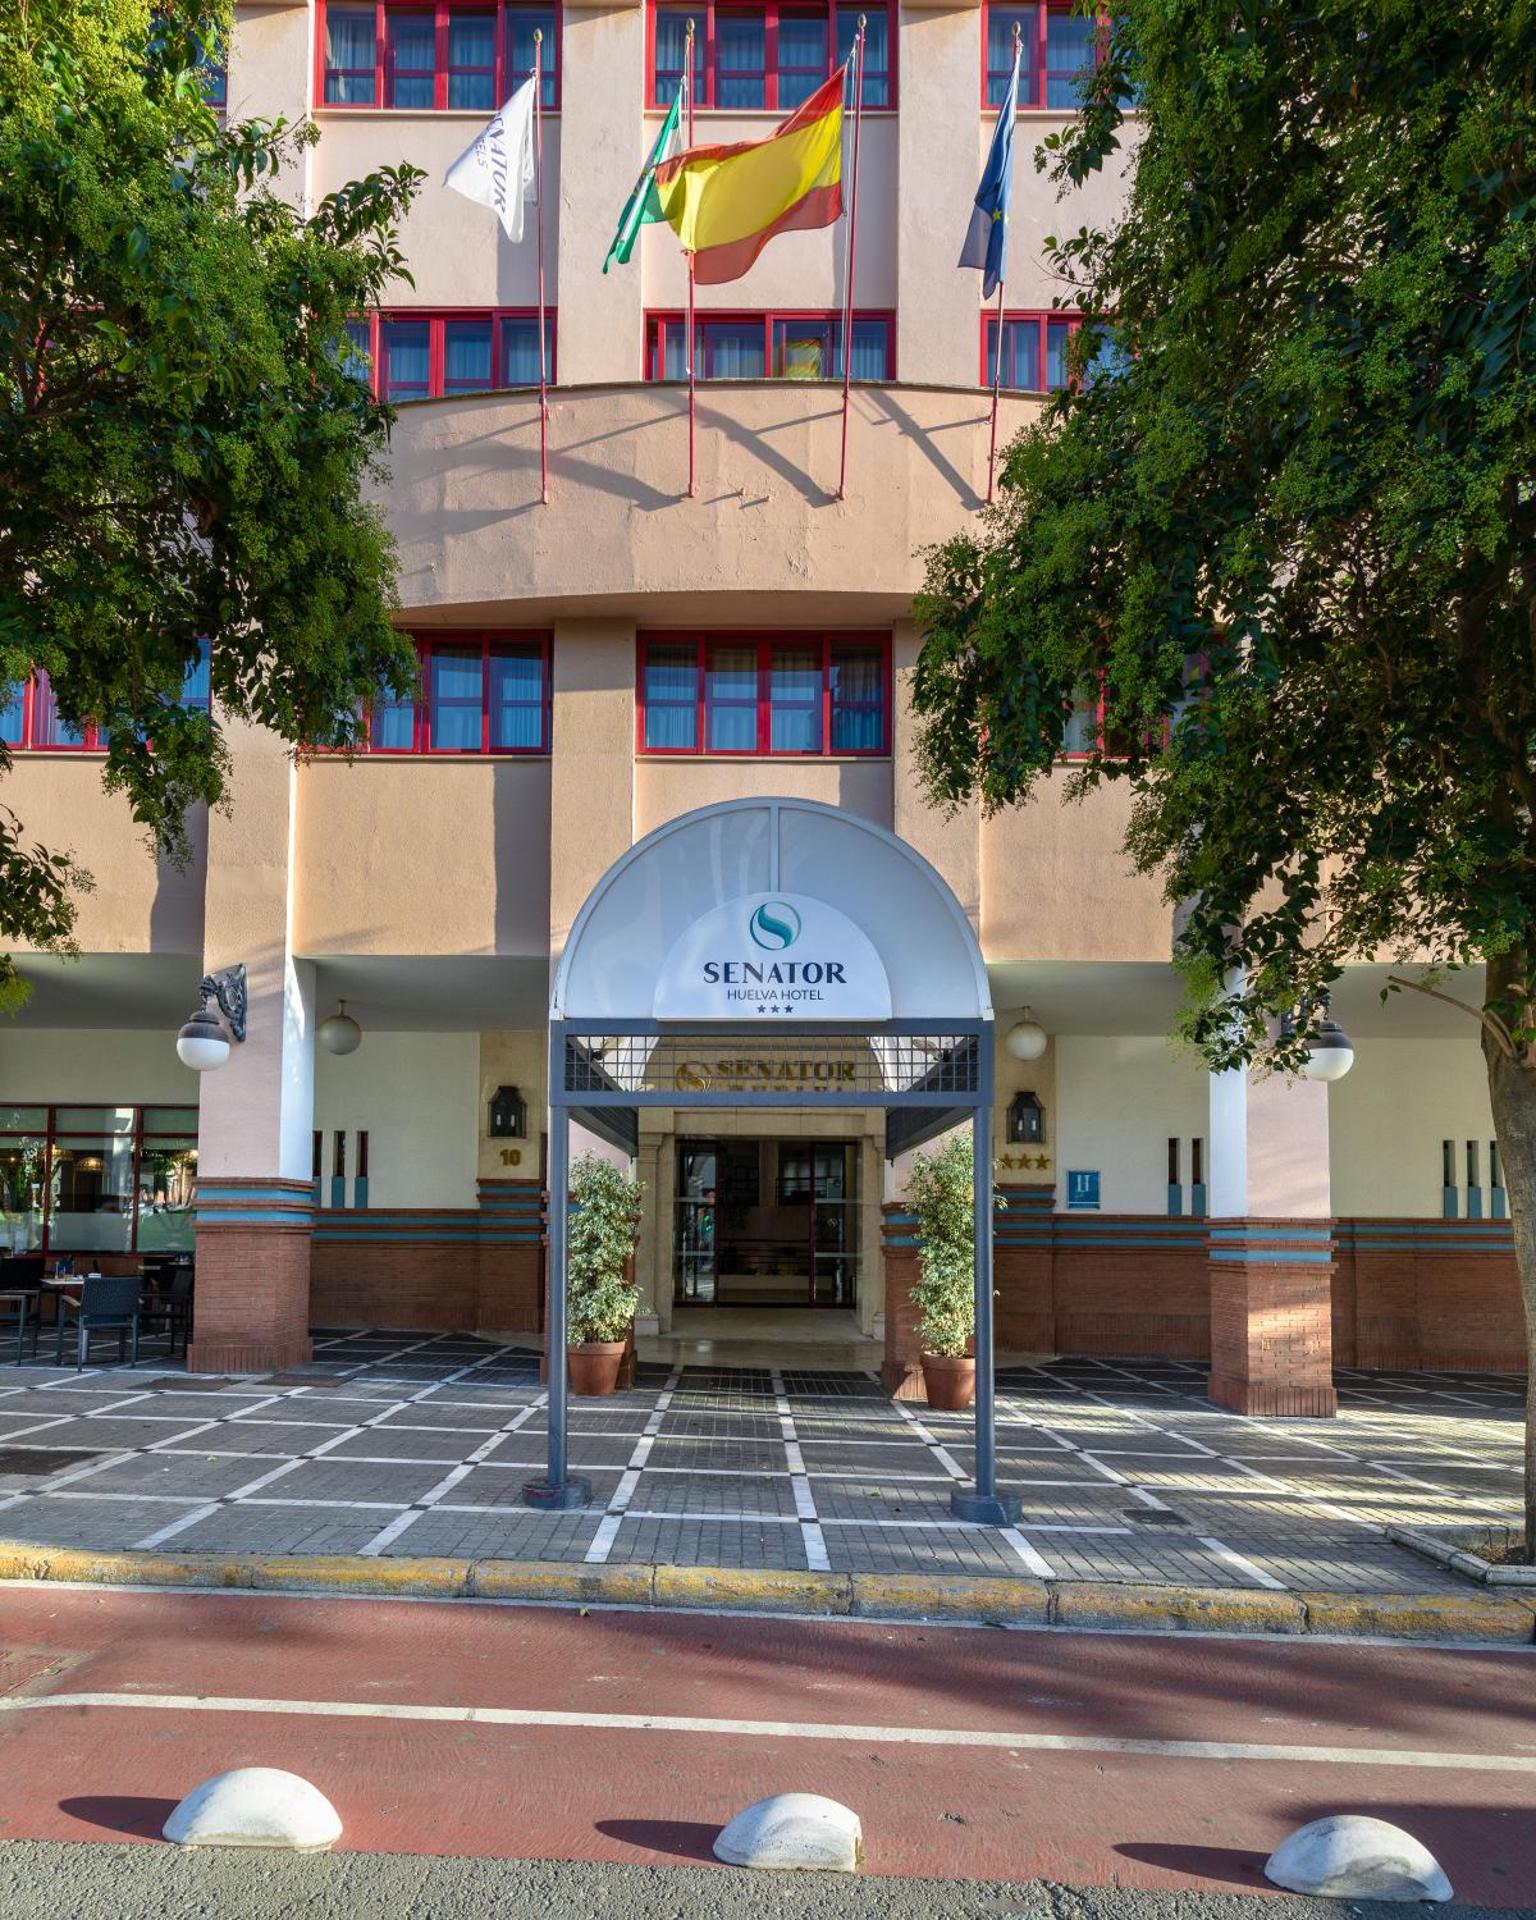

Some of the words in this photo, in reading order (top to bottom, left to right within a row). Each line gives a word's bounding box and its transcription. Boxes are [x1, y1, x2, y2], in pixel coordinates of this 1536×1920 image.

[703, 962, 848, 984] SENATOR
[727, 989, 778, 1001] HUELVA
[781, 989, 824, 1001] HOTEL
[716, 1060, 857, 1082] SENATOR
[500, 1149, 521, 1167] 10
